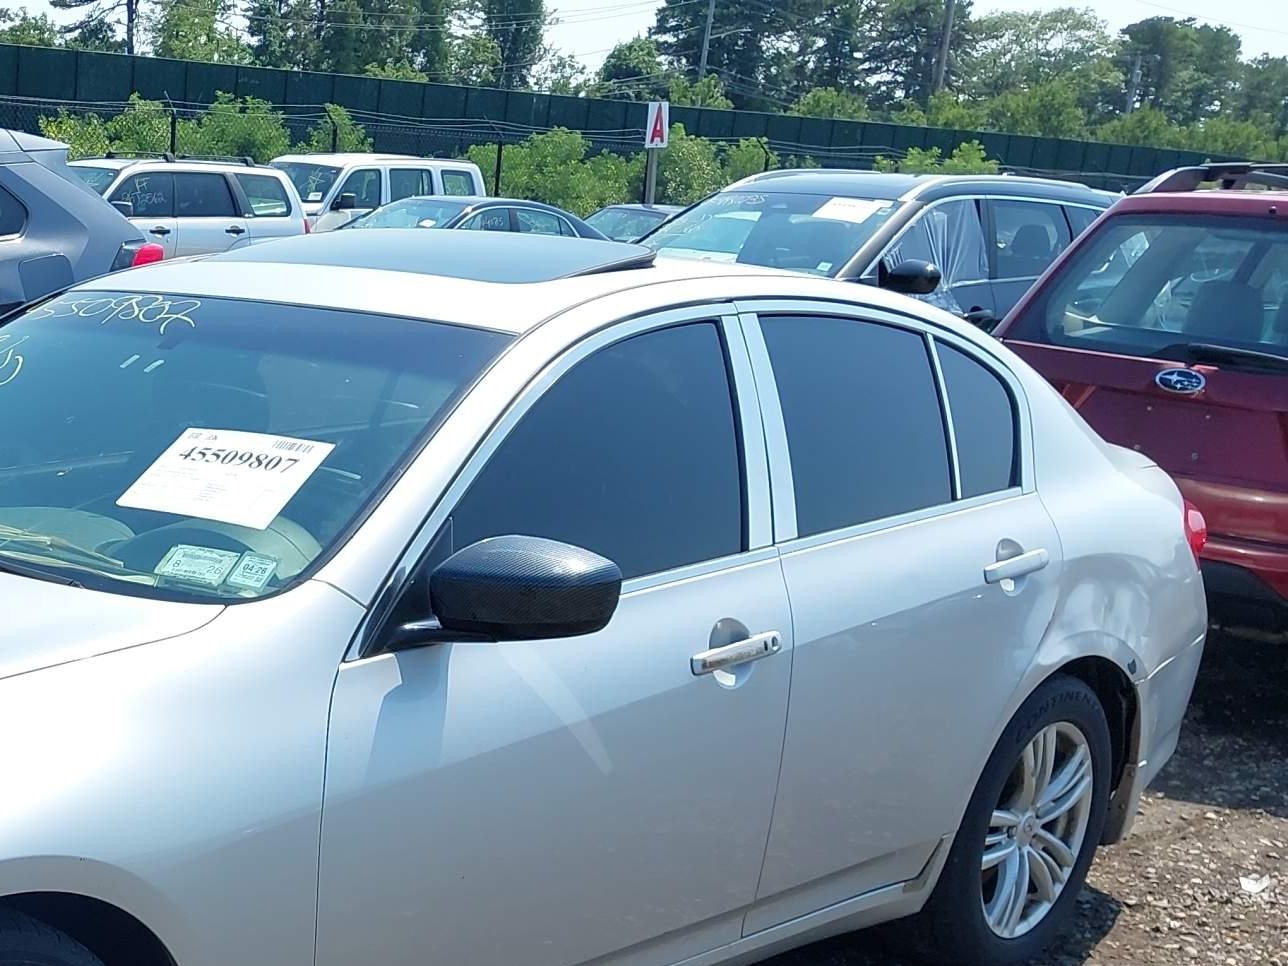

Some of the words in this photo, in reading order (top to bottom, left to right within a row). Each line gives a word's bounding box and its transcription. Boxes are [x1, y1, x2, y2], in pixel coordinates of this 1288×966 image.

[649, 102, 665, 145] A
[178, 446, 300, 473] 45509807
[207, 565, 223, 575] 26
